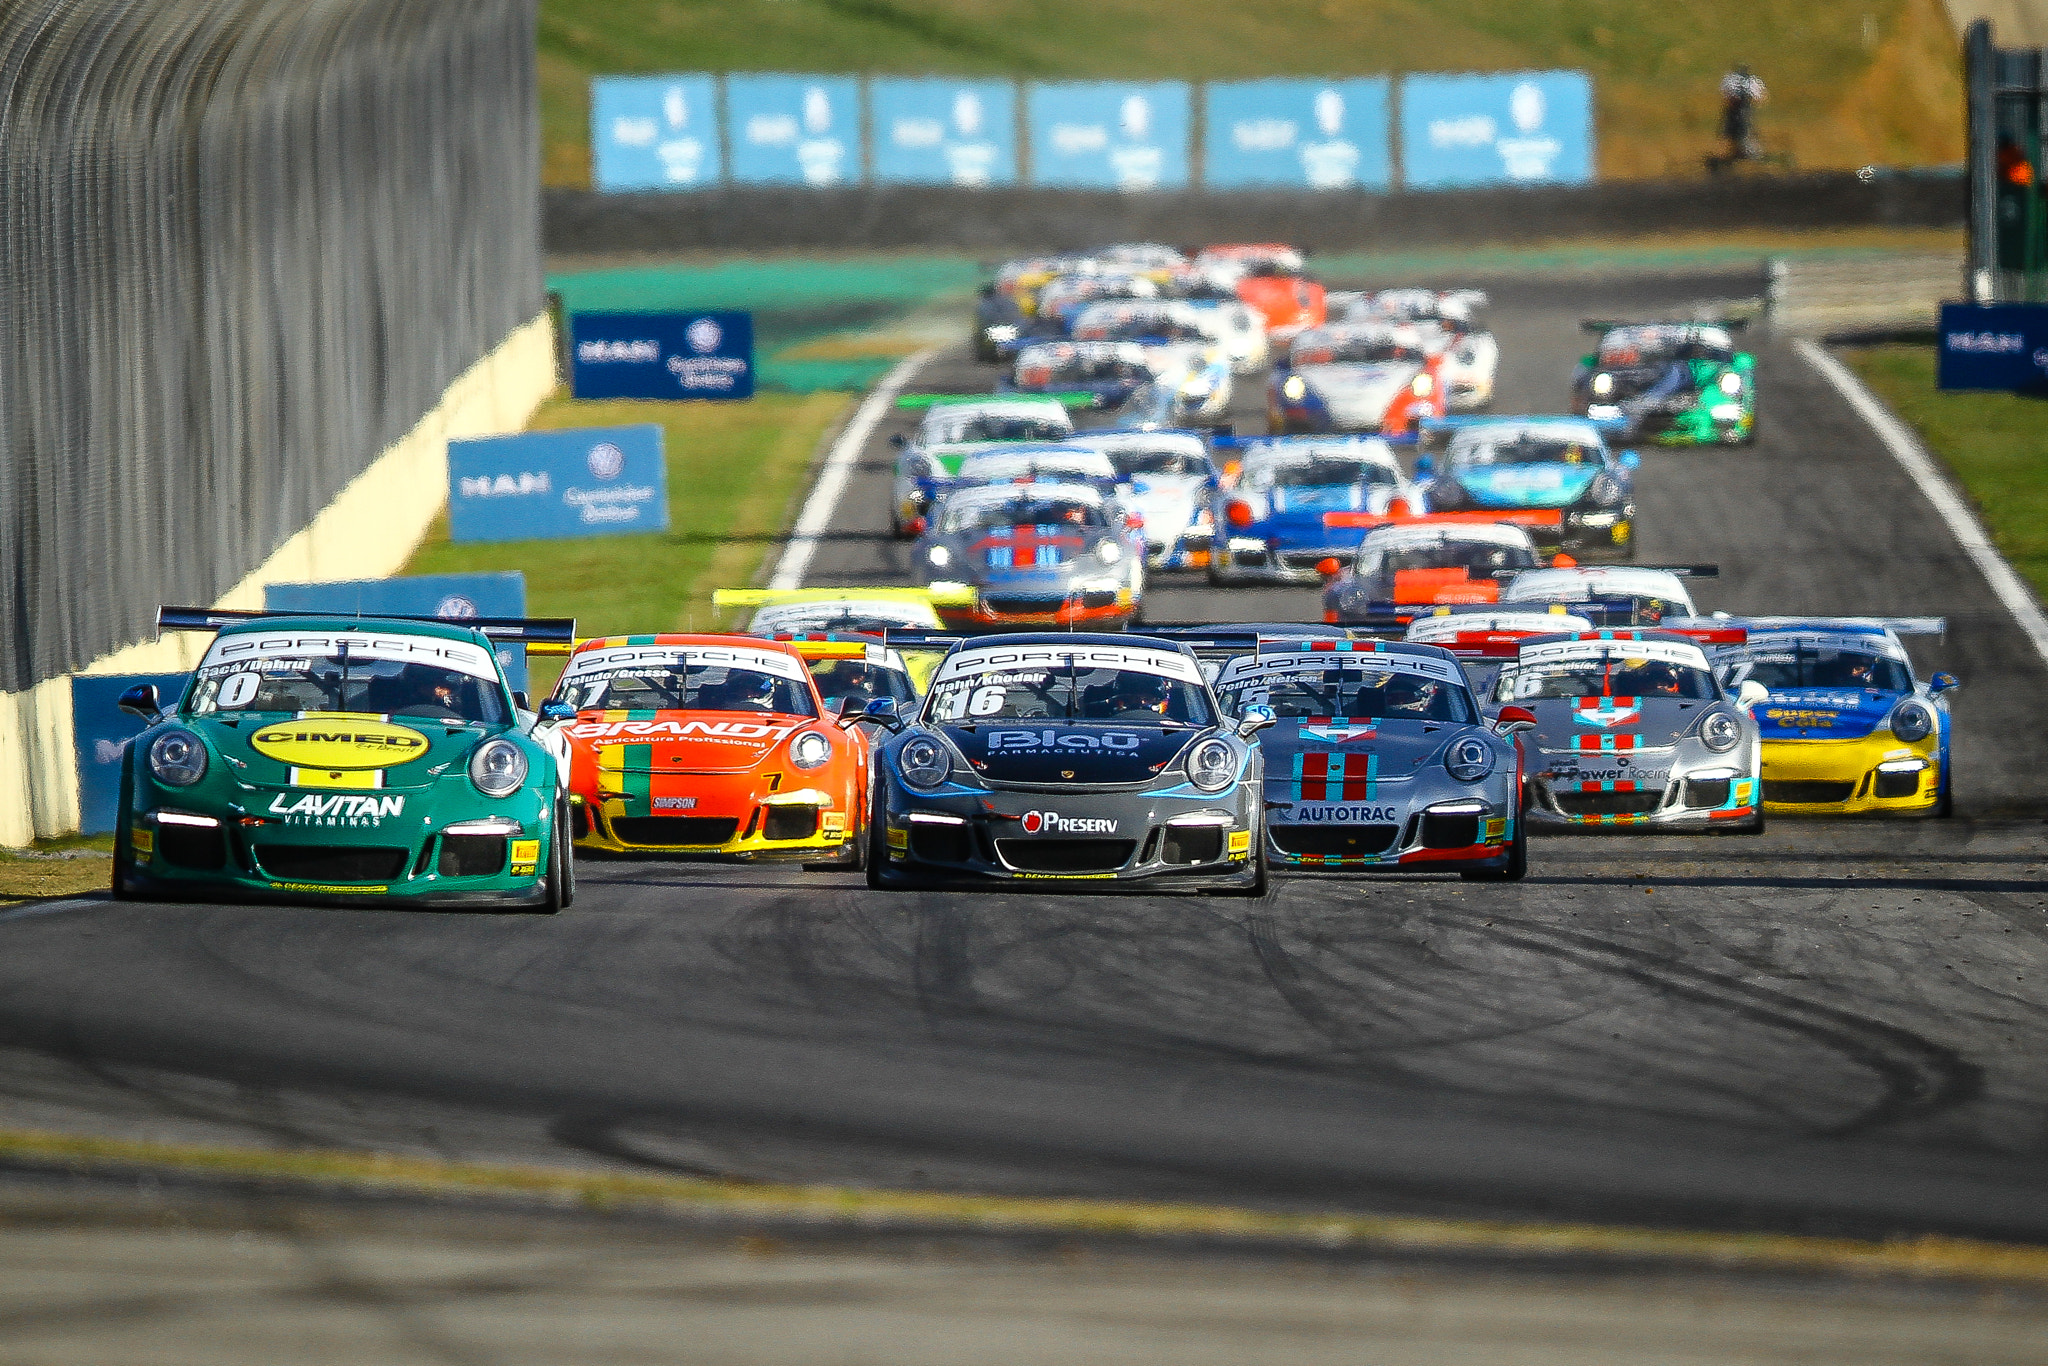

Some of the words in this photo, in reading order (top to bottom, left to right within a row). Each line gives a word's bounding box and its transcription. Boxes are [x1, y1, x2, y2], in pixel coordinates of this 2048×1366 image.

[220, 638, 477, 665] PORSCHE
[577, 651, 789, 671] PORSCHE
[955, 652, 1185, 673] PORSCHE
[1235, 656, 1448, 677] PORSCHE
[216, 671, 262, 708] 0
[582, 680, 609, 708] 7
[1514, 672, 1543, 699] 6
[950, 685, 1007, 720] 16
[1766, 707, 1840, 720] Super
[1778, 717, 1833, 728] Cola
[256, 732, 422, 747] CIMED
[572, 721, 794, 741] BRANDT
[593, 736, 673, 746] Agricultura
[679, 735, 766, 749] Profissional
[760, 771, 784, 792] 7
[268, 792, 405, 818] LAVITAN
[653, 797, 697, 809] SIMPSON
[284, 814, 382, 827] VITAMINAS
[1298, 807, 1396, 820] AUTOTRAC
